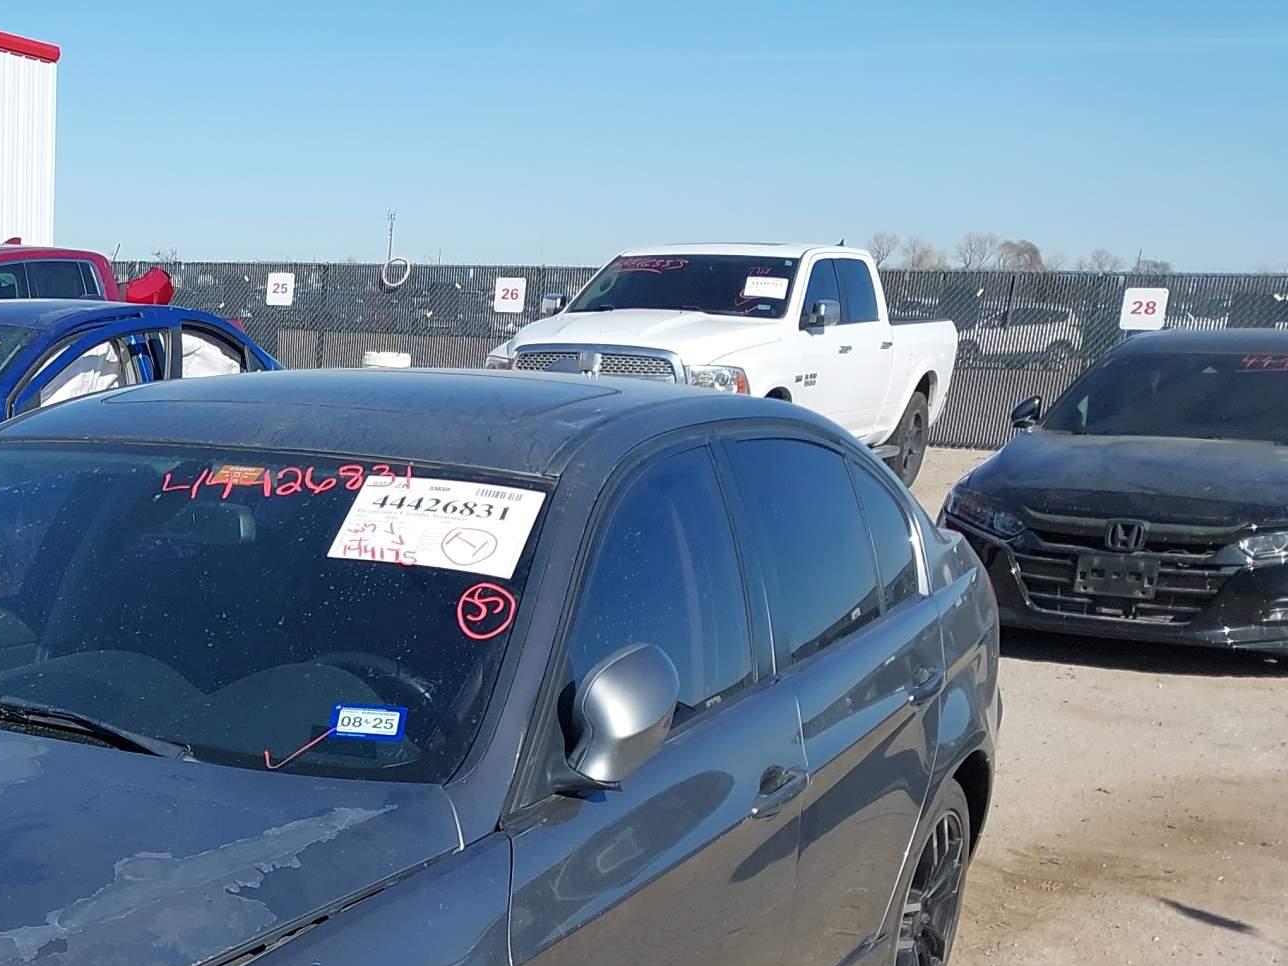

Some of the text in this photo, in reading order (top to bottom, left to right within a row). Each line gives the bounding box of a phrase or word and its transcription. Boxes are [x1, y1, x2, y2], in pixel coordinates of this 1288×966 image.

[272, 282, 288, 294] 25
[501, 288, 519, 301] 26
[1130, 300, 1157, 316] 28
[162, 463, 412, 501] 44426831
[371, 494, 511, 522] 44426831
